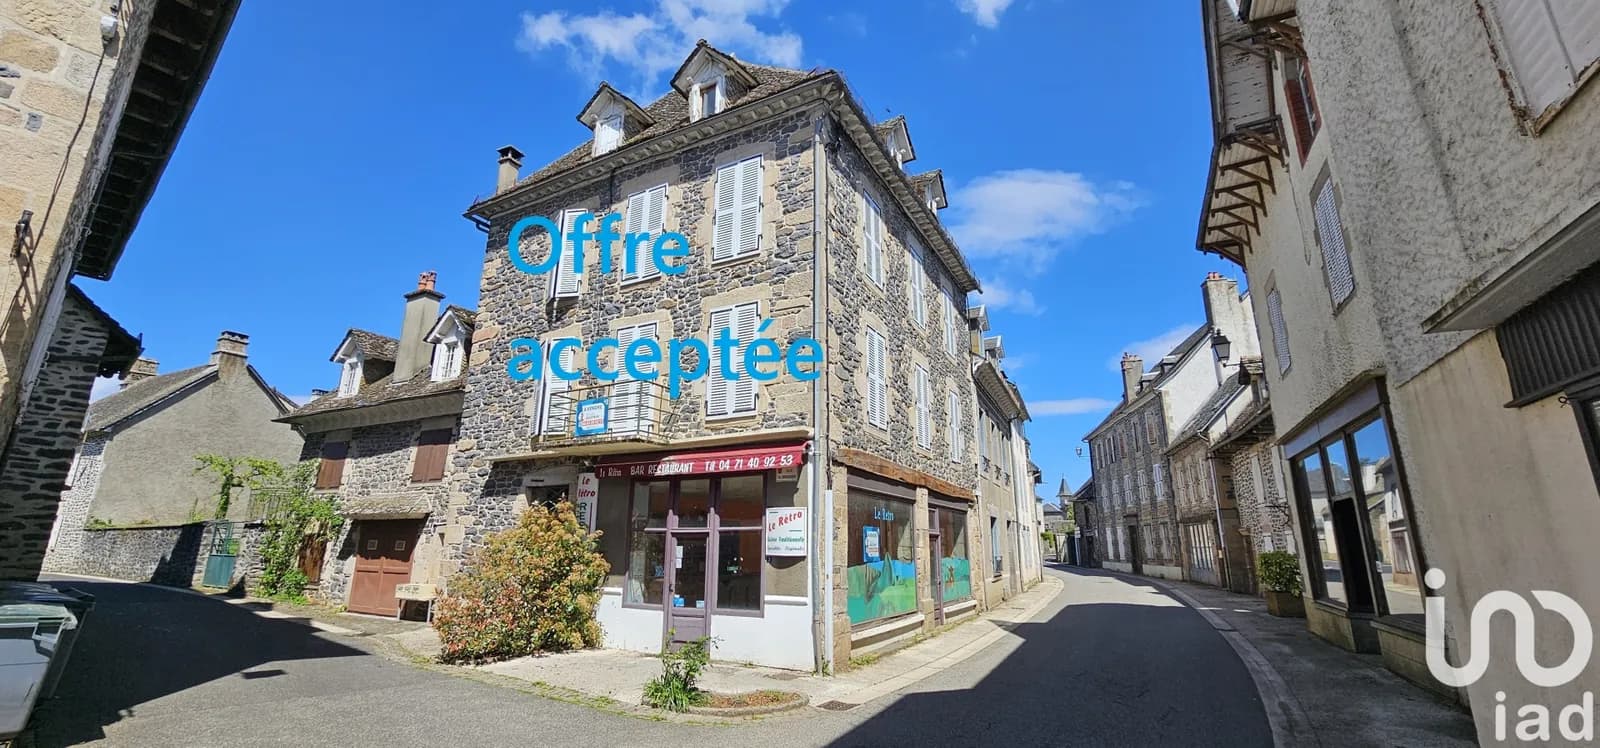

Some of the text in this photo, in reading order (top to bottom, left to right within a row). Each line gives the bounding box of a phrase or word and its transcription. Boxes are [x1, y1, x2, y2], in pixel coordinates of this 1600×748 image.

[630, 464, 645, 476] BAR
[648, 461, 694, 475] RESTAURANT
[719, 459, 730, 470] 04
[734, 458, 744, 469] 71
[748, 457, 759, 468] 40
[764, 456, 776, 466] 92
[780, 455, 793, 465] 53
[873, 506, 880, 520] Le
